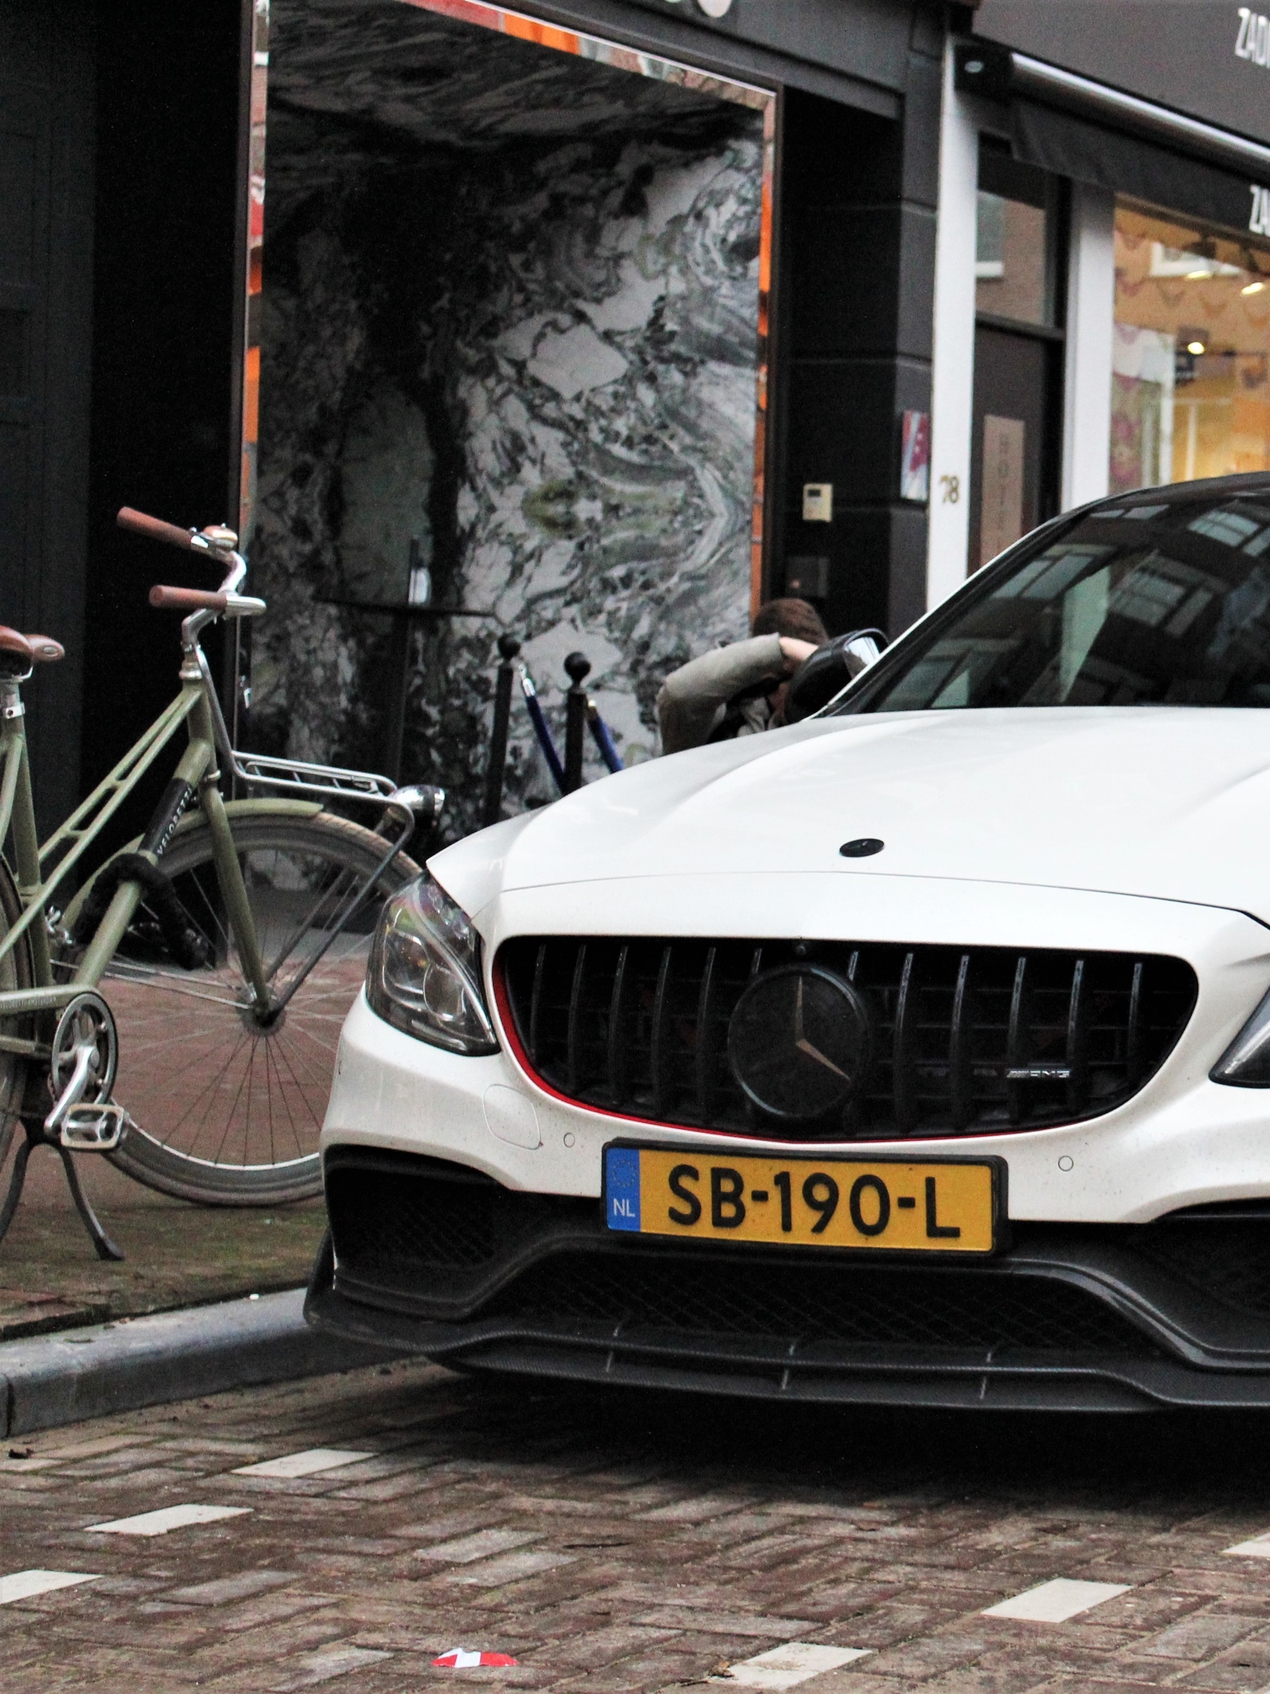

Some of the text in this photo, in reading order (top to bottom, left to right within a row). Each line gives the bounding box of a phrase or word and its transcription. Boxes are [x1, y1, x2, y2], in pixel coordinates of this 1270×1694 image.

[938, 475, 960, 504] 78
[613, 1164, 961, 1238] NL SB-190-L
